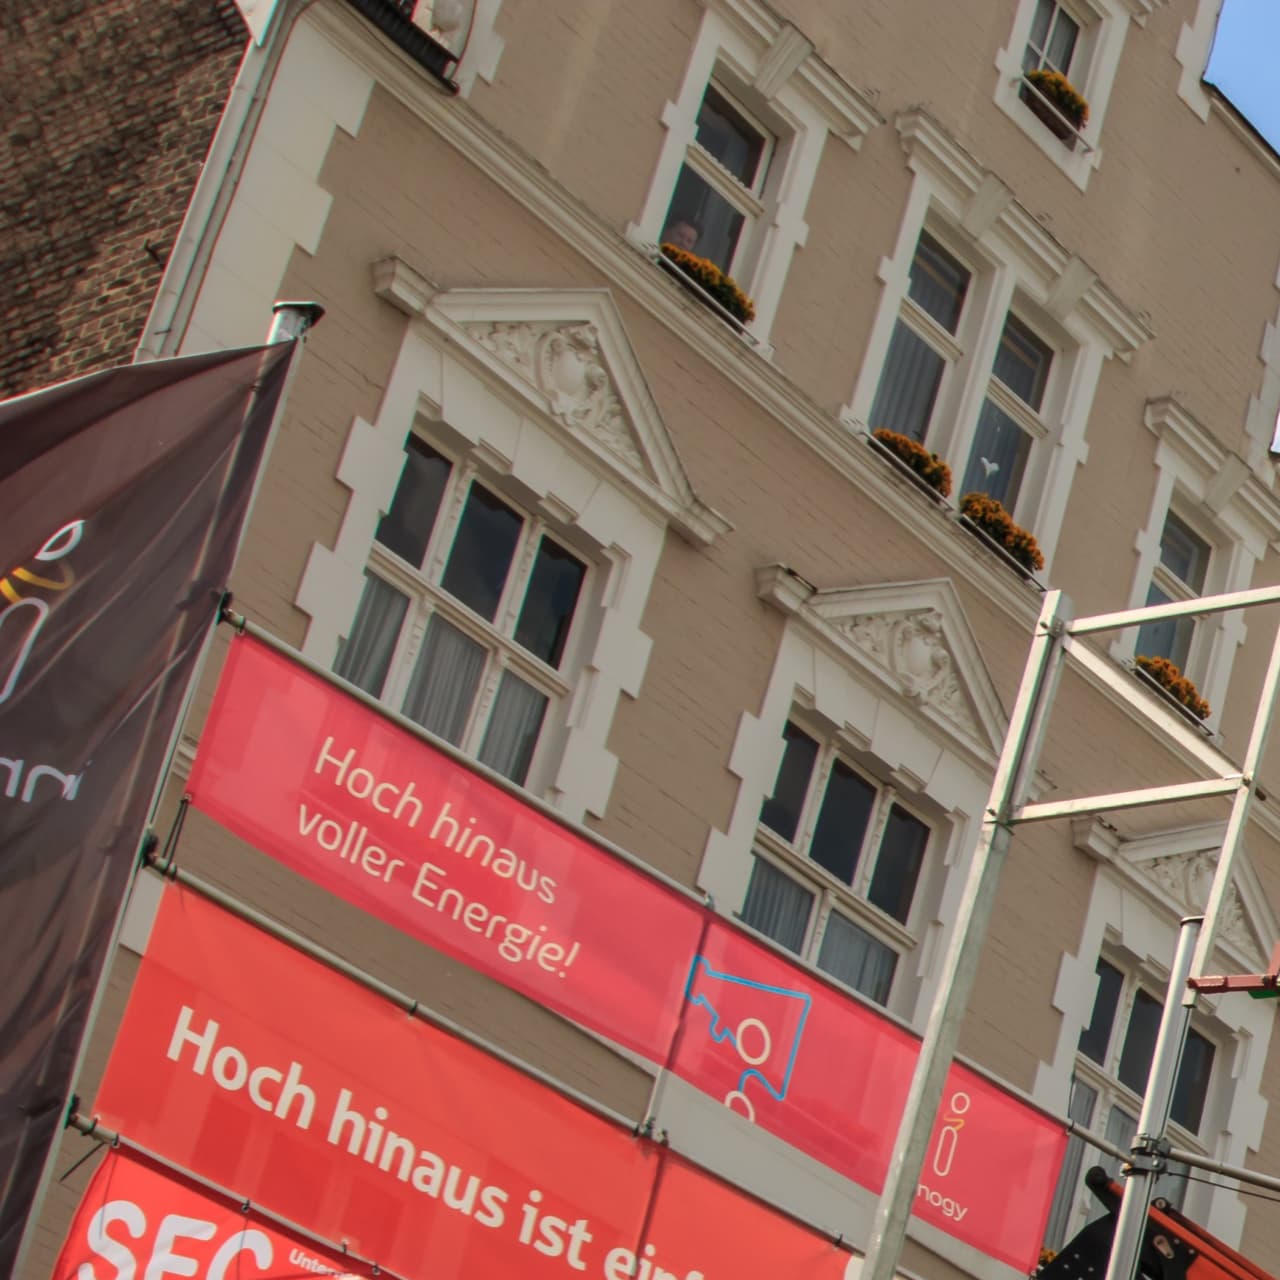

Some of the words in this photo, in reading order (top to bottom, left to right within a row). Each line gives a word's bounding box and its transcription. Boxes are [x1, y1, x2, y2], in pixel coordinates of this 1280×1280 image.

[298, 803, 405, 885] voller
[411, 863, 581, 978] Energie!
[314, 736, 425, 828] Hoch
[429, 802, 557, 905] hinaus
[166, 1004, 317, 1130] Hoch
[327, 1088, 509, 1229] hinaus
[517, 1189, 594, 1271] ist
[917, 1183, 969, 1222] nogy
